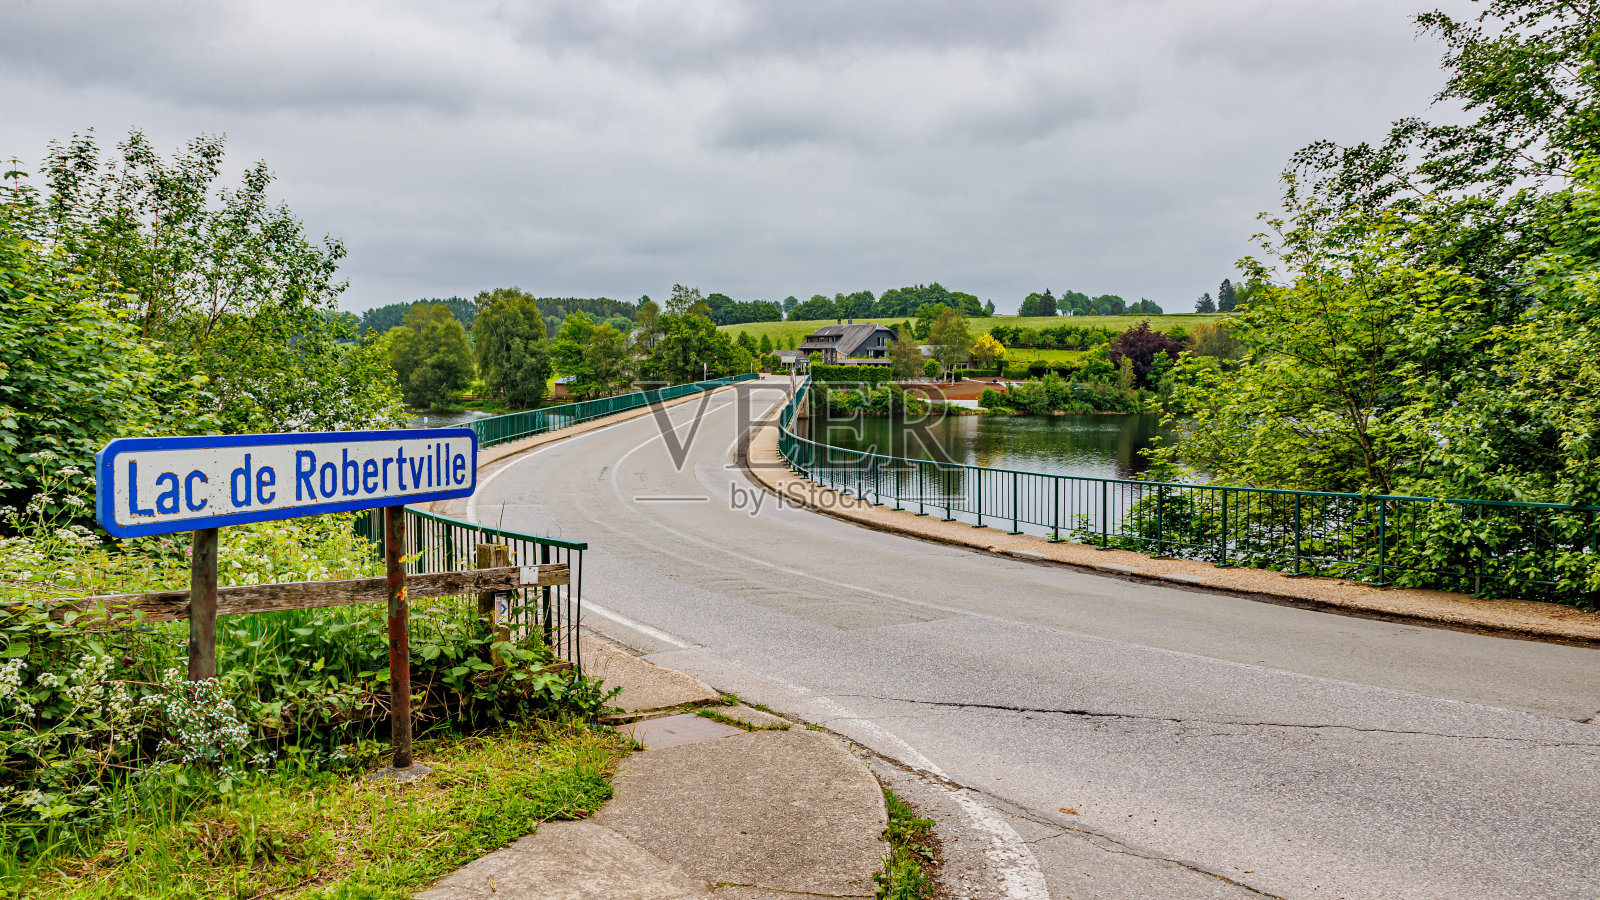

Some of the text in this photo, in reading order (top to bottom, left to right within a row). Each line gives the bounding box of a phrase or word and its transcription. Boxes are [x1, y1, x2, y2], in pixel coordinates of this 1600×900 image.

[128, 442, 466, 518] Lac de Robertville
